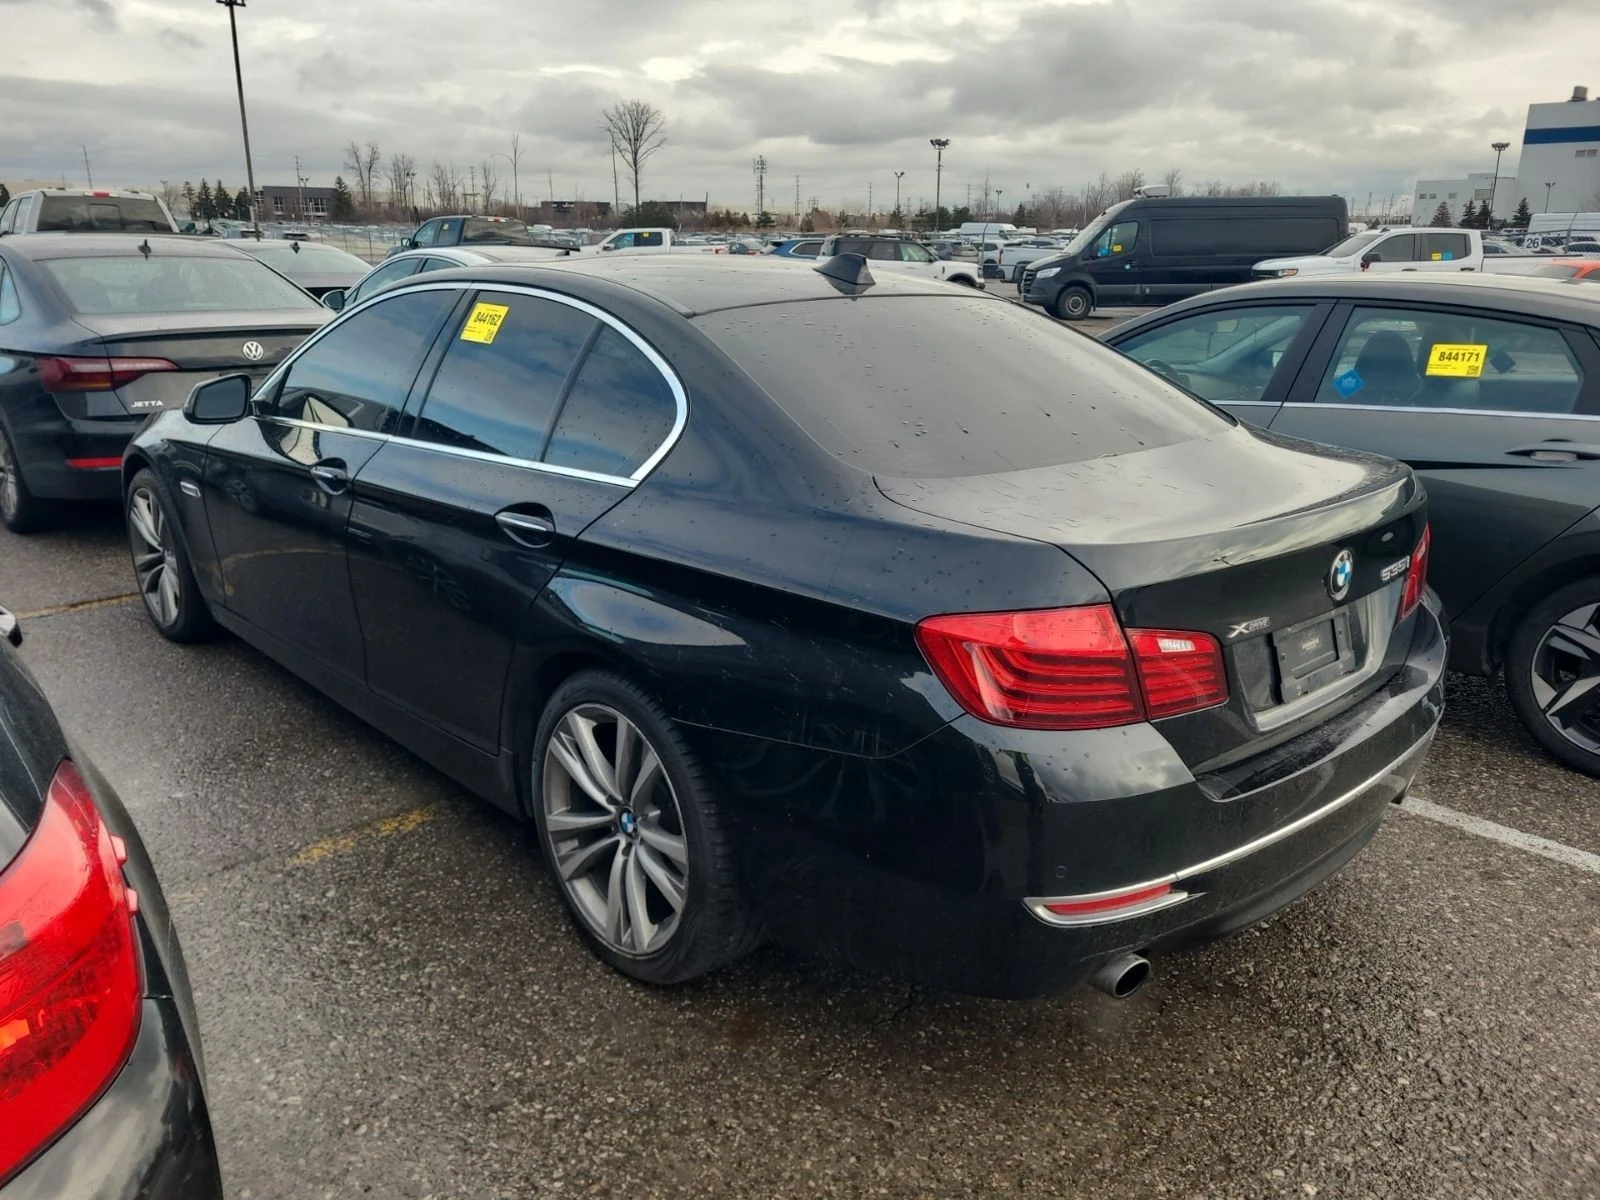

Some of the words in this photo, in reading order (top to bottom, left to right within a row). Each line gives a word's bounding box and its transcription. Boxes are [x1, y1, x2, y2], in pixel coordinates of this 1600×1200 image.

[1526, 238, 1540, 249] 26
[474, 312, 501, 326] 844162
[243, 341, 263, 360] VW
[1439, 352, 1480, 362] 844171
[131, 400, 164, 408] JETTA
